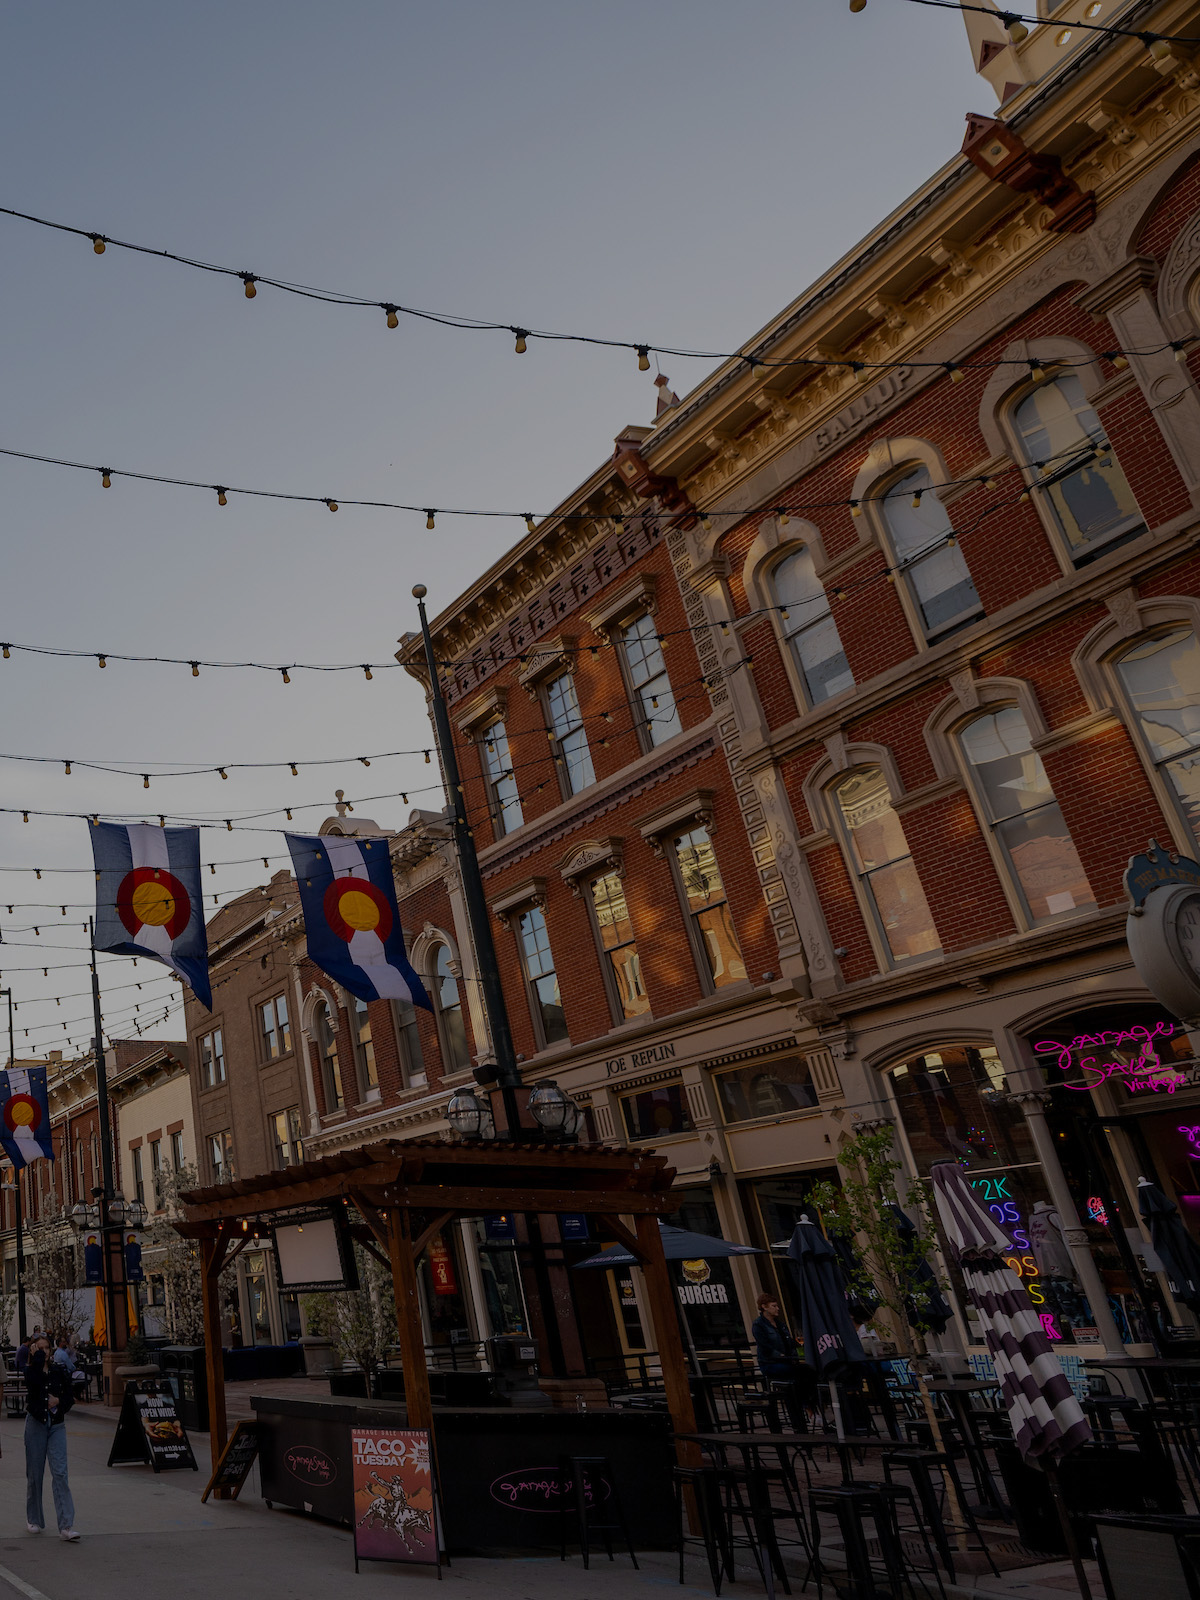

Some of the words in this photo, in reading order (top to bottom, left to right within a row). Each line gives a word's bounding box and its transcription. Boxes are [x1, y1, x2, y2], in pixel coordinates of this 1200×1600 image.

[816, 366, 914, 452] GALLUP
[1134, 868, 1157, 889] THE
[605, 1057, 627, 1078] JOE
[631, 1043, 676, 1068] REPLIN
[971, 1176, 1012, 1201] 2K
[677, 1283, 729, 1305] BURGER
[146, 1397, 164, 1407] NOW
[140, 1407, 158, 1418] OPEN
[158, 1407, 177, 1418] WIDE
[381, 1429, 397, 1437] SALE
[400, 1430, 428, 1438] VINTAGE
[353, 1438, 406, 1456] TACO
[354, 1454, 407, 1467] TUESDAY
